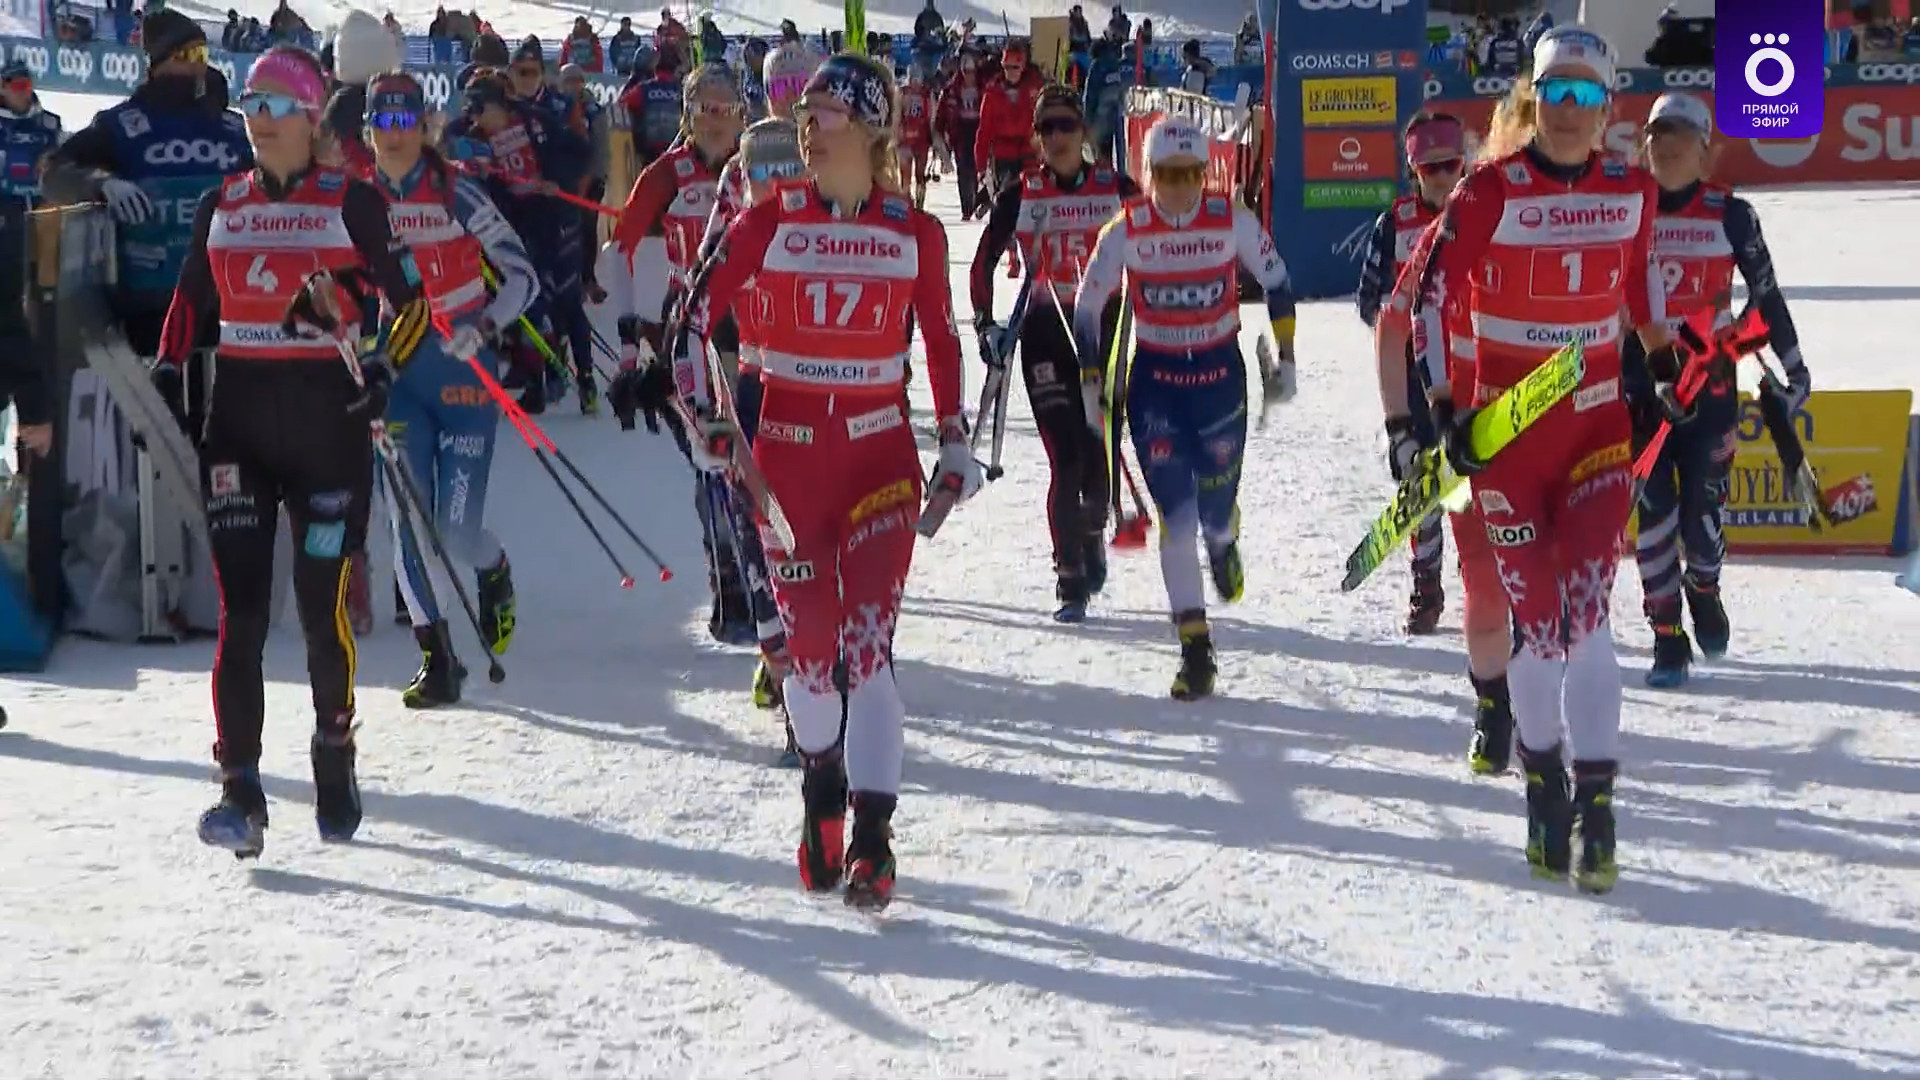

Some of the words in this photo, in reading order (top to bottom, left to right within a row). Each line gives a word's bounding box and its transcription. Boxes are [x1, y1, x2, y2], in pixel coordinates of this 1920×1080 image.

[57, 46, 93, 83] coop
[102, 52, 139, 88] coop
[1292, 53, 1369, 70] GOMS.CH
[1664, 69, 1715, 89] coo
[1332, 161, 1369, 172] Sunrise
[1051, 202, 1112, 218] Sunrise
[1548, 202, 1629, 226] Sunrise
[251, 213, 328, 232] Sunrise
[815, 233, 902, 260] Sunrise
[1160, 236, 1225, 256] Sunrise
[246, 254, 279, 293] 4
[1561, 251, 1583, 293] 1
[1609, 269, 1620, 289] 1
[1660, 260, 1685, 294] 9
[805, 281, 863, 327] 17
[873, 304, 885, 327] 1
[795, 362, 864, 381] GOMS.CH
